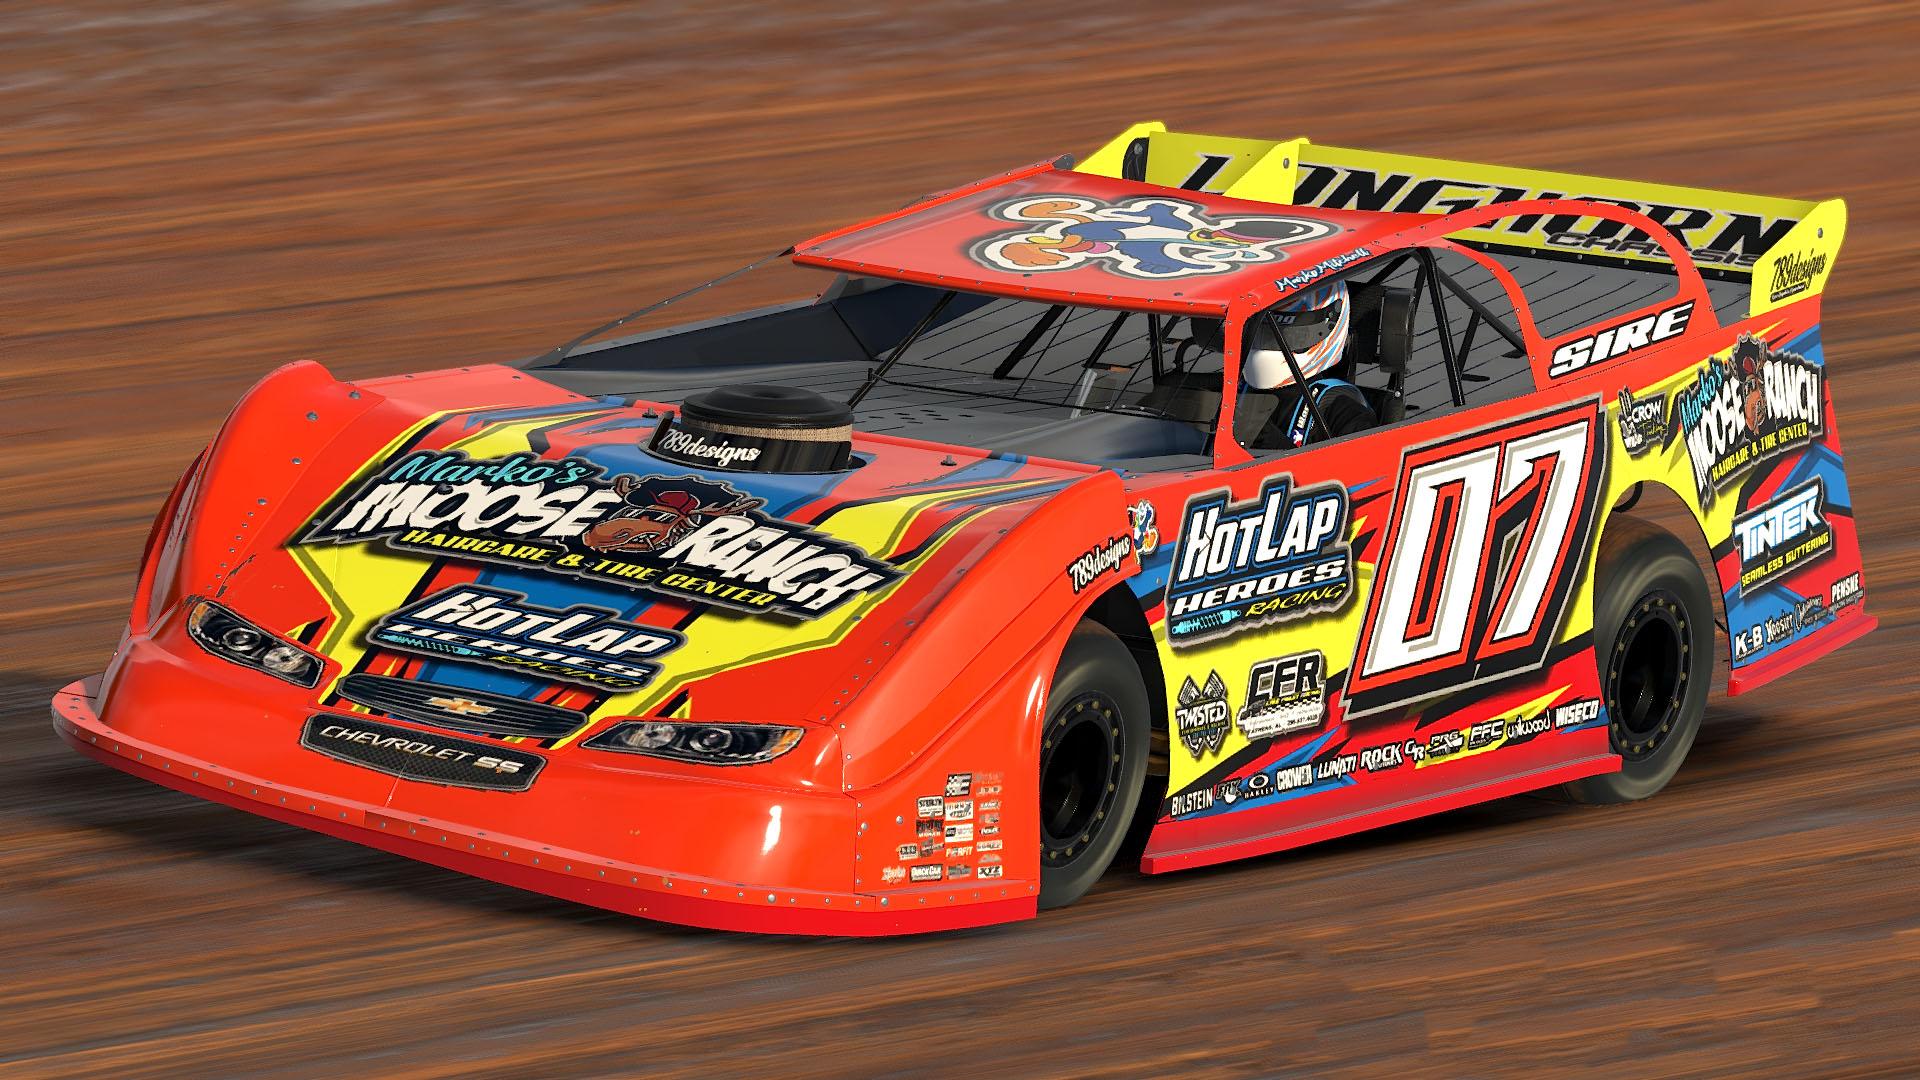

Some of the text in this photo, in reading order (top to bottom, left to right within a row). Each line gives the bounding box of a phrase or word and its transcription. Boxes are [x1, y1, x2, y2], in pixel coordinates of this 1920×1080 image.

[1275, 269, 1318, 292] Marko
[1770, 248, 1827, 292] 789designs
[1549, 302, 1694, 377] SIRE
[1632, 400, 1662, 423] CROW
[1680, 362, 1723, 434] Marko's
[1687, 360, 1819, 490] MOOSE RANCH
[1760, 432, 1777, 452] TIRE
[1779, 422, 1808, 443] CENTER
[389, 455, 596, 484] Marko's
[658, 428, 761, 467] 789designs
[331, 480, 886, 610] MOOSE RANCH
[1069, 536, 1130, 592] 789designs
[1361, 420, 1589, 677] 07
[1741, 532, 1829, 587] SEAMLESS GUTTERING
[400, 529, 777, 606] HAIRCARE & TIRE CENTER
[1171, 559, 1346, 616] HEROES
[1831, 573, 1859, 602] PENSKE
[1245, 583, 1347, 617] RACING
[386, 624, 652, 677] HEROES
[1735, 625, 1763, 656] K-B
[1555, 700, 1600, 728] WISECO
[320, 725, 525, 774] CHEVROLET SS
[1317, 755, 1357, 780] LUNATI
[1171, 788, 1213, 816] BILSTEIN
